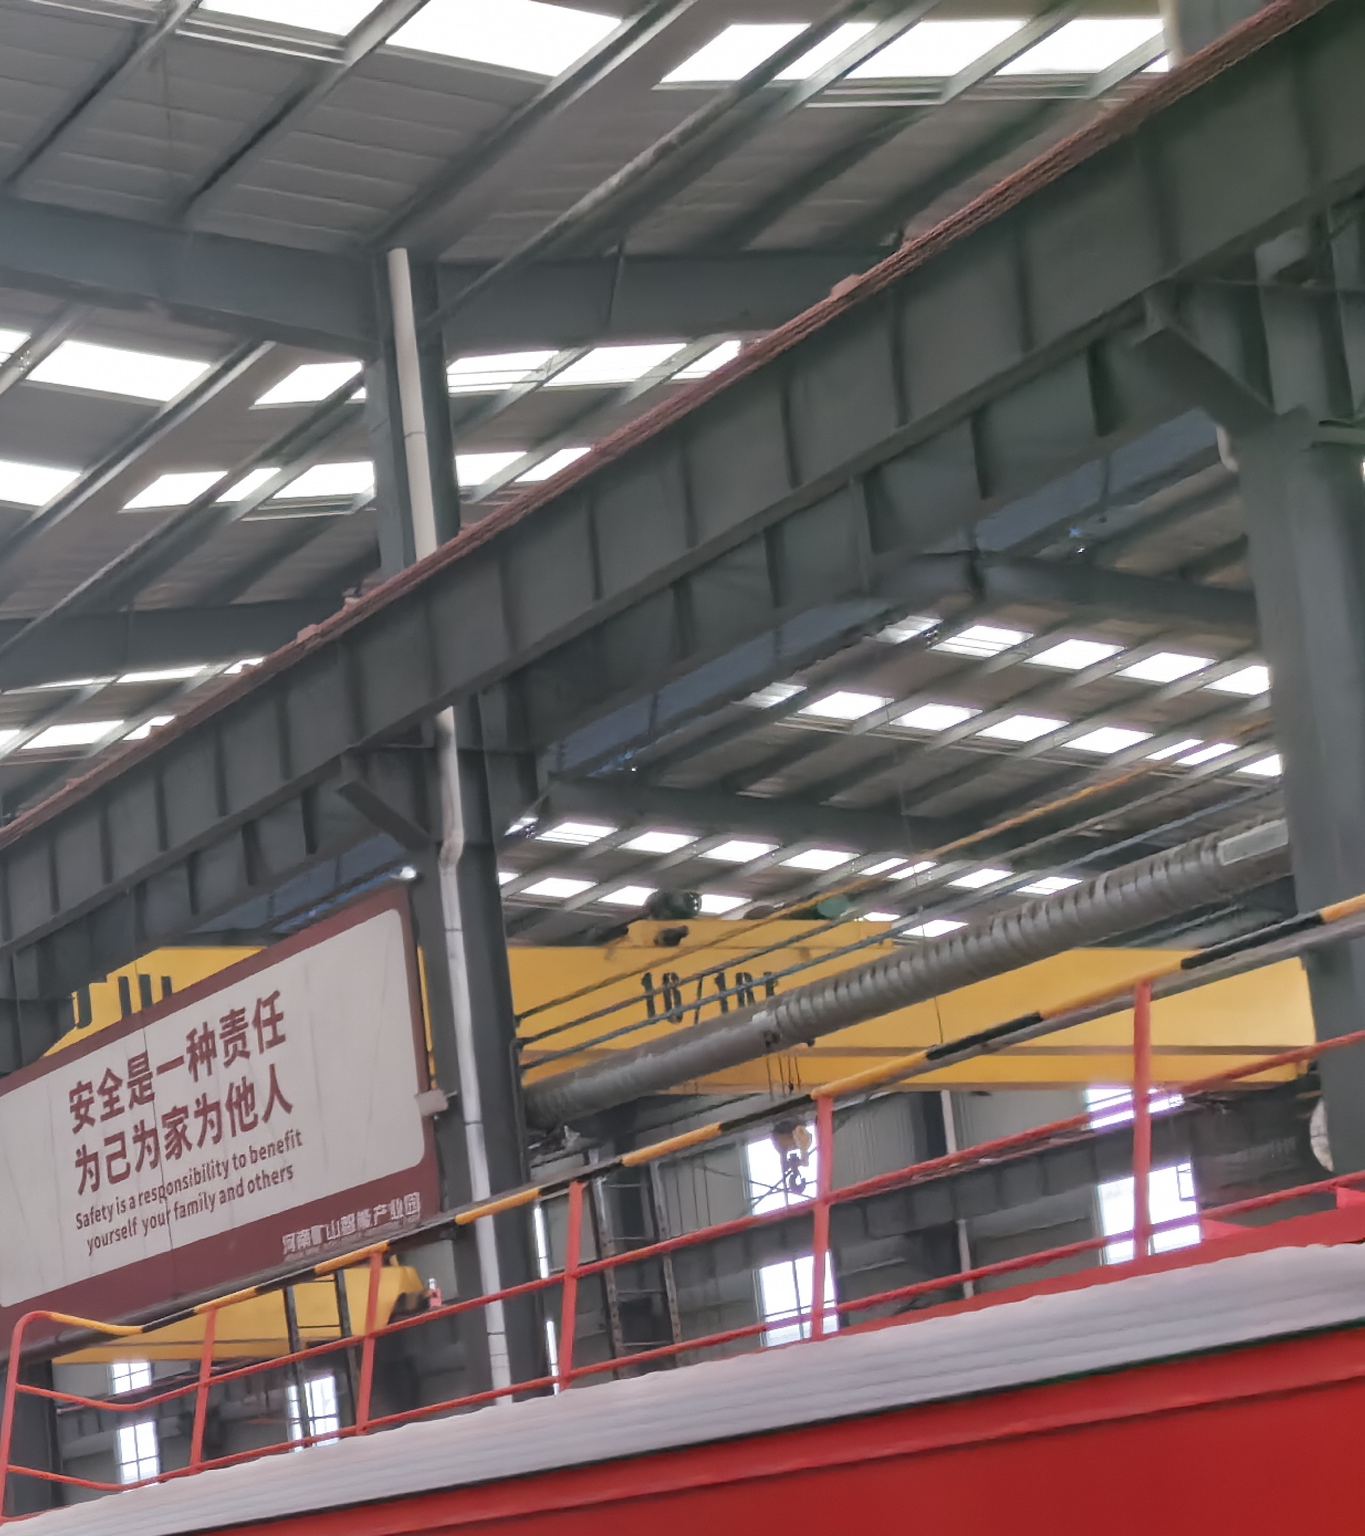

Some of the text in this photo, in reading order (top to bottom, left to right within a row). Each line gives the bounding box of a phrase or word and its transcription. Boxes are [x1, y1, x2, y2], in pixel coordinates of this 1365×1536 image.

[69, 990, 286, 1135] 安全是一种责任
[74, 1063, 293, 1196] 为己为家为他人
[75, 1128, 303, 1230] Safety is a responsibility to benefit
[87, 1163, 294, 1256] yourself your family and others
